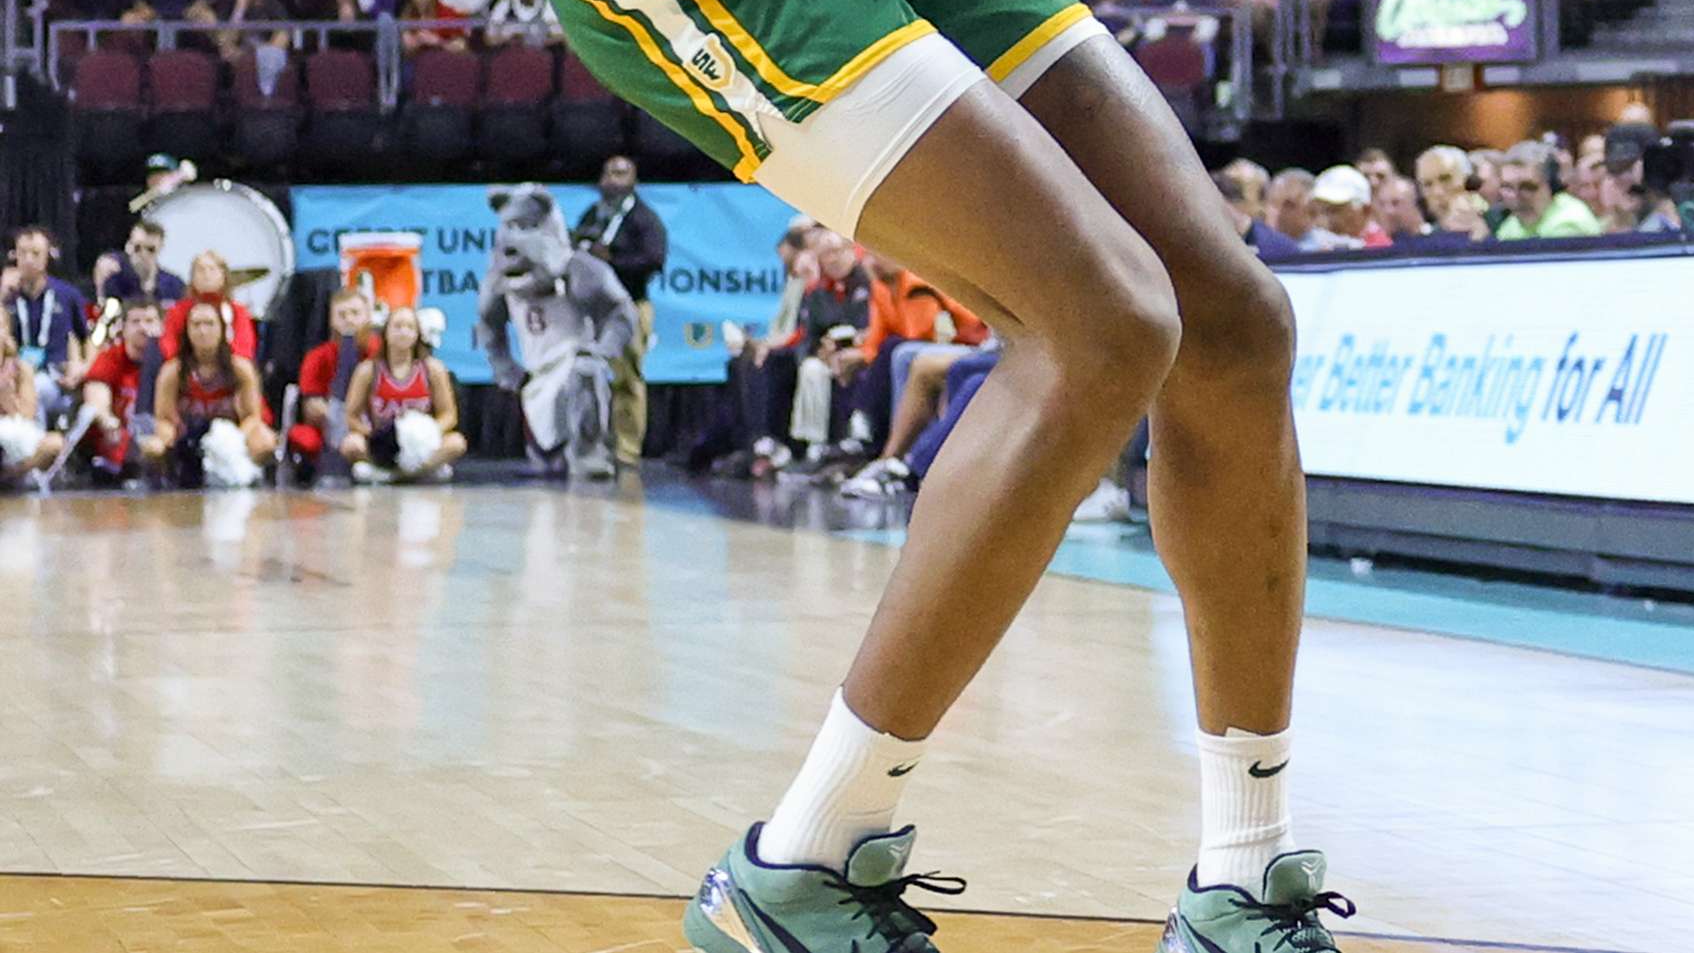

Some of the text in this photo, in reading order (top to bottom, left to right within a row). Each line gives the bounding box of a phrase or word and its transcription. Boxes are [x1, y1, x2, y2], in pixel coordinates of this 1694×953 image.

[1316, 332, 1414, 416] Better
[1406, 332, 1545, 445] Banking
[1540, 330, 1607, 424] for
[1594, 332, 1669, 425] All
